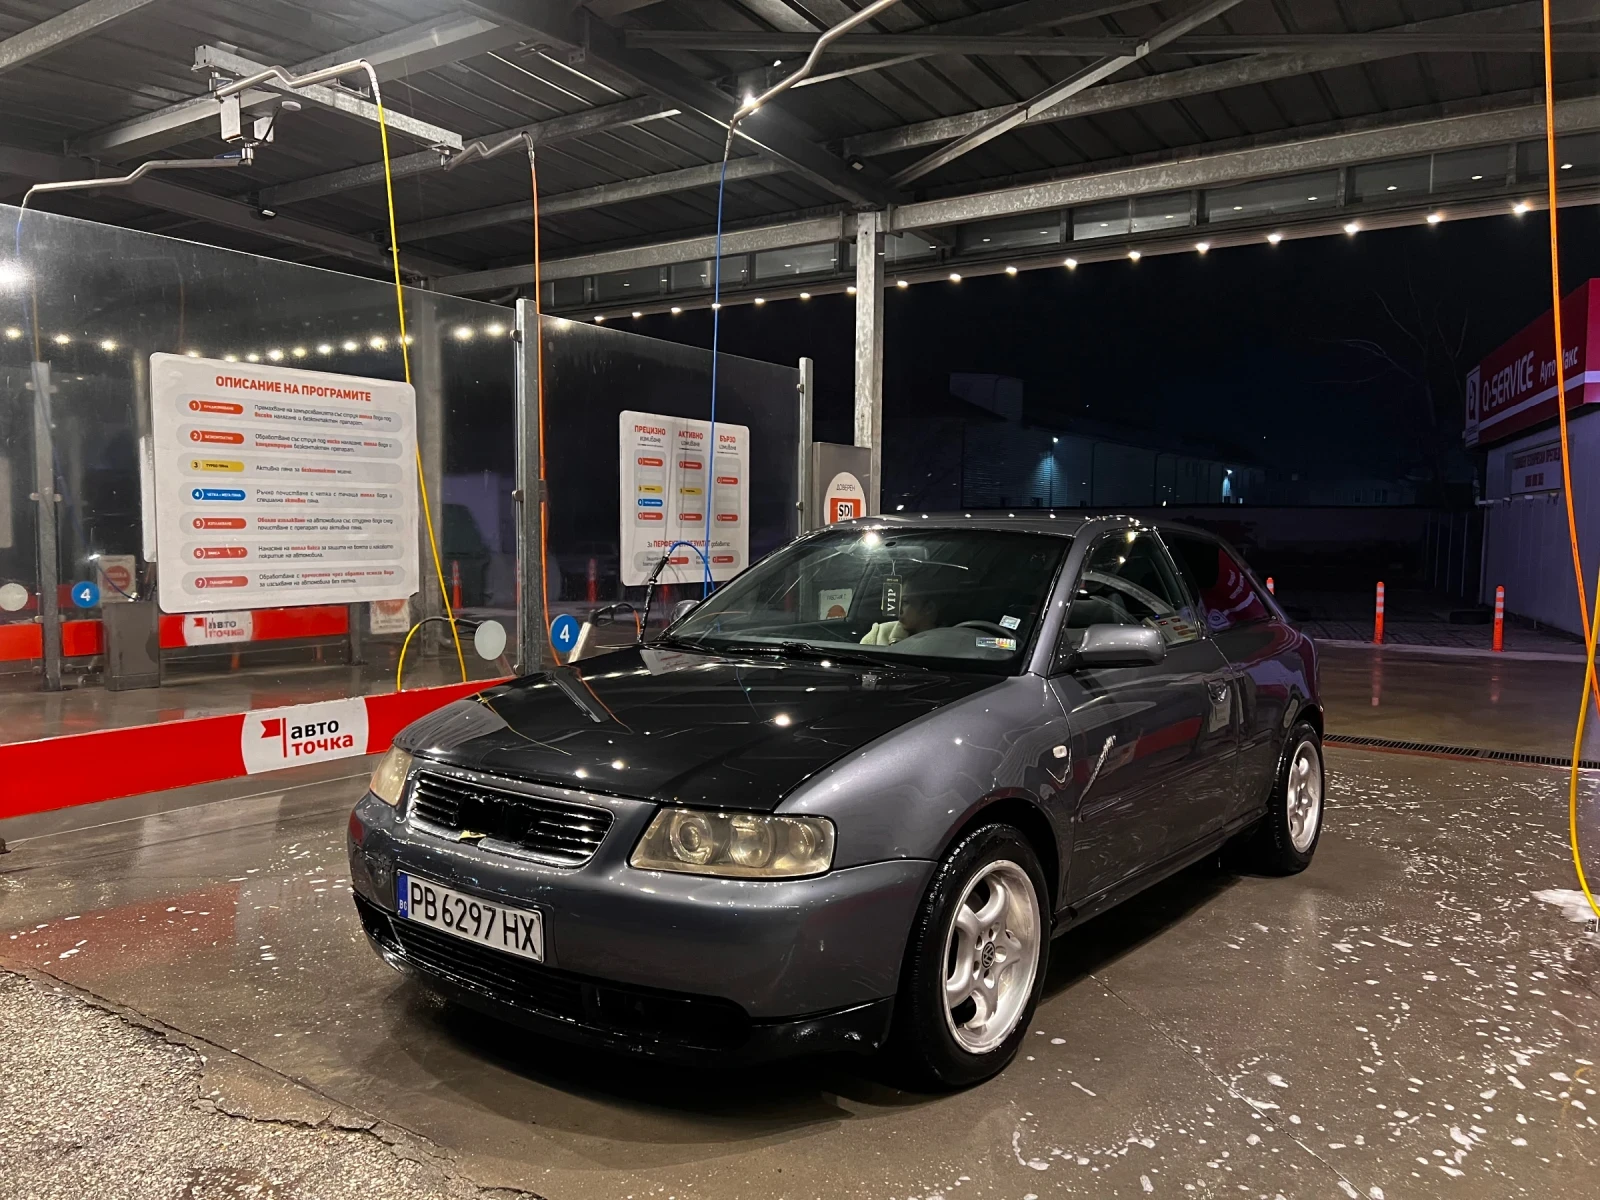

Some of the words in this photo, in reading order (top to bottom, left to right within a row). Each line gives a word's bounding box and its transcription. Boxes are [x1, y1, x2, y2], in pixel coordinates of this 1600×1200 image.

[216, 376, 281, 393] ОПИСАНИЕ
[283, 383, 299, 395] НА
[300, 384, 371, 402] ПРОГРАМИТЕ
[634, 425, 666, 435] ПРЕЦИЗНО
[678, 430, 703, 440] АКТИВНО
[719, 435, 736, 443] БЪРЗО
[836, 483, 856, 491] ДОВЕРЕН
[839, 504, 852, 517] SDI
[80, 588, 91, 602] 4
[887, 588, 896, 611] VIP
[559, 624, 570, 643] 4
[291, 720, 339, 740] авто
[292, 734, 354, 756] точка
[400, 899, 407, 910] BG
[411, 881, 437, 922] PB
[442, 893, 496, 940] 6297
[502, 910, 537, 954] HX
